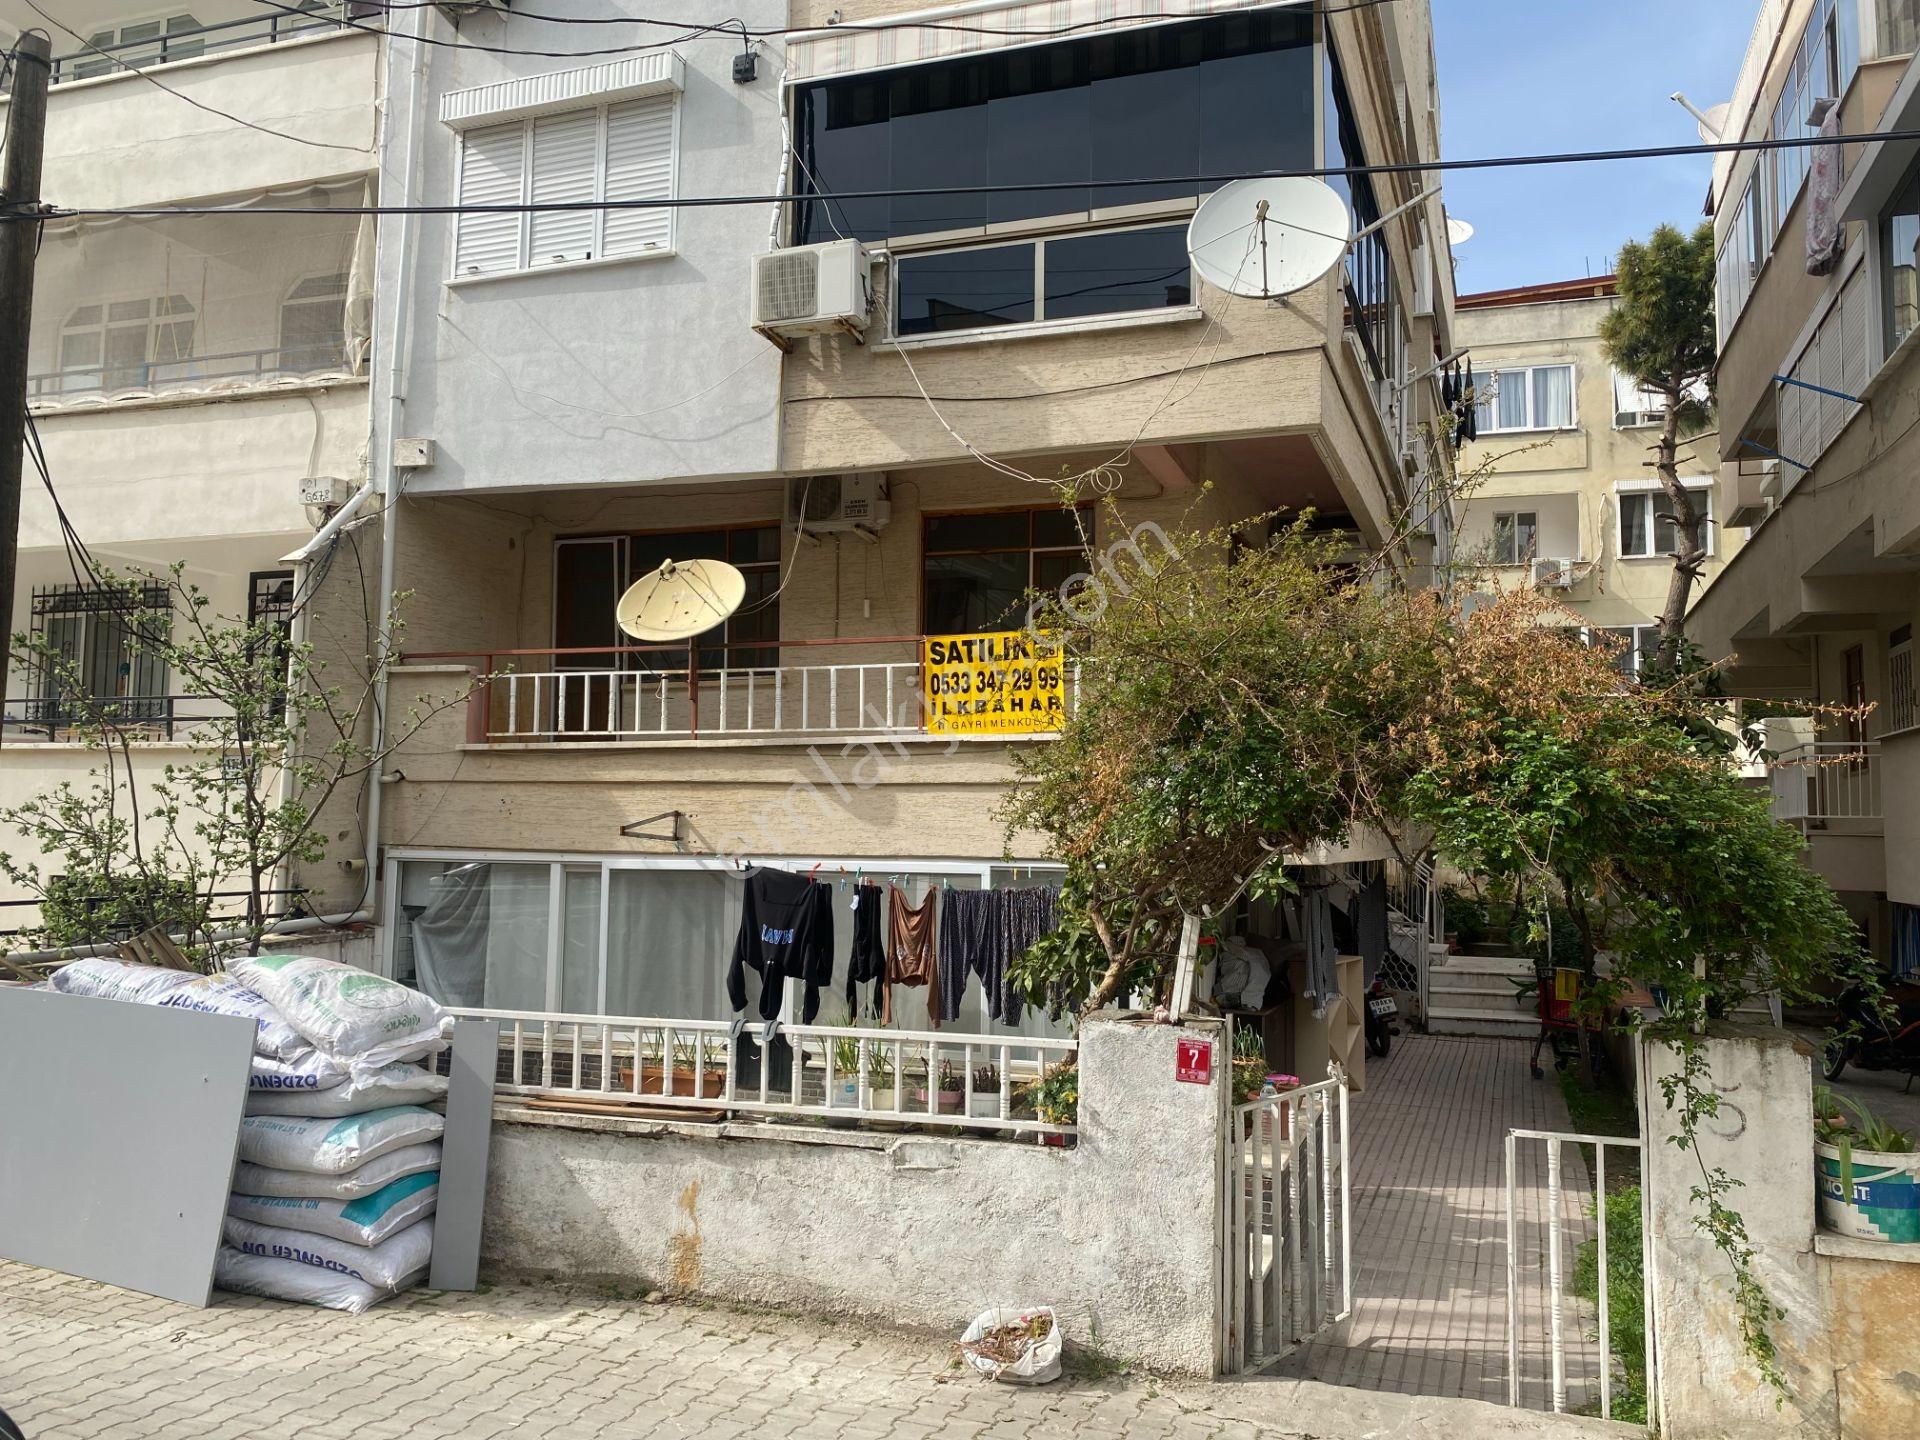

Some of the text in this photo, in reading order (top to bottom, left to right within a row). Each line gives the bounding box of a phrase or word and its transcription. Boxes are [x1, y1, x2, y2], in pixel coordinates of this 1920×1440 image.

[929, 637, 1032, 666] SATILIK
[930, 671, 971, 696] 0533
[1012, 667, 1032, 691] 29
[1037, 666, 1059, 690] 99
[1189, 1049, 1199, 1069] 7
